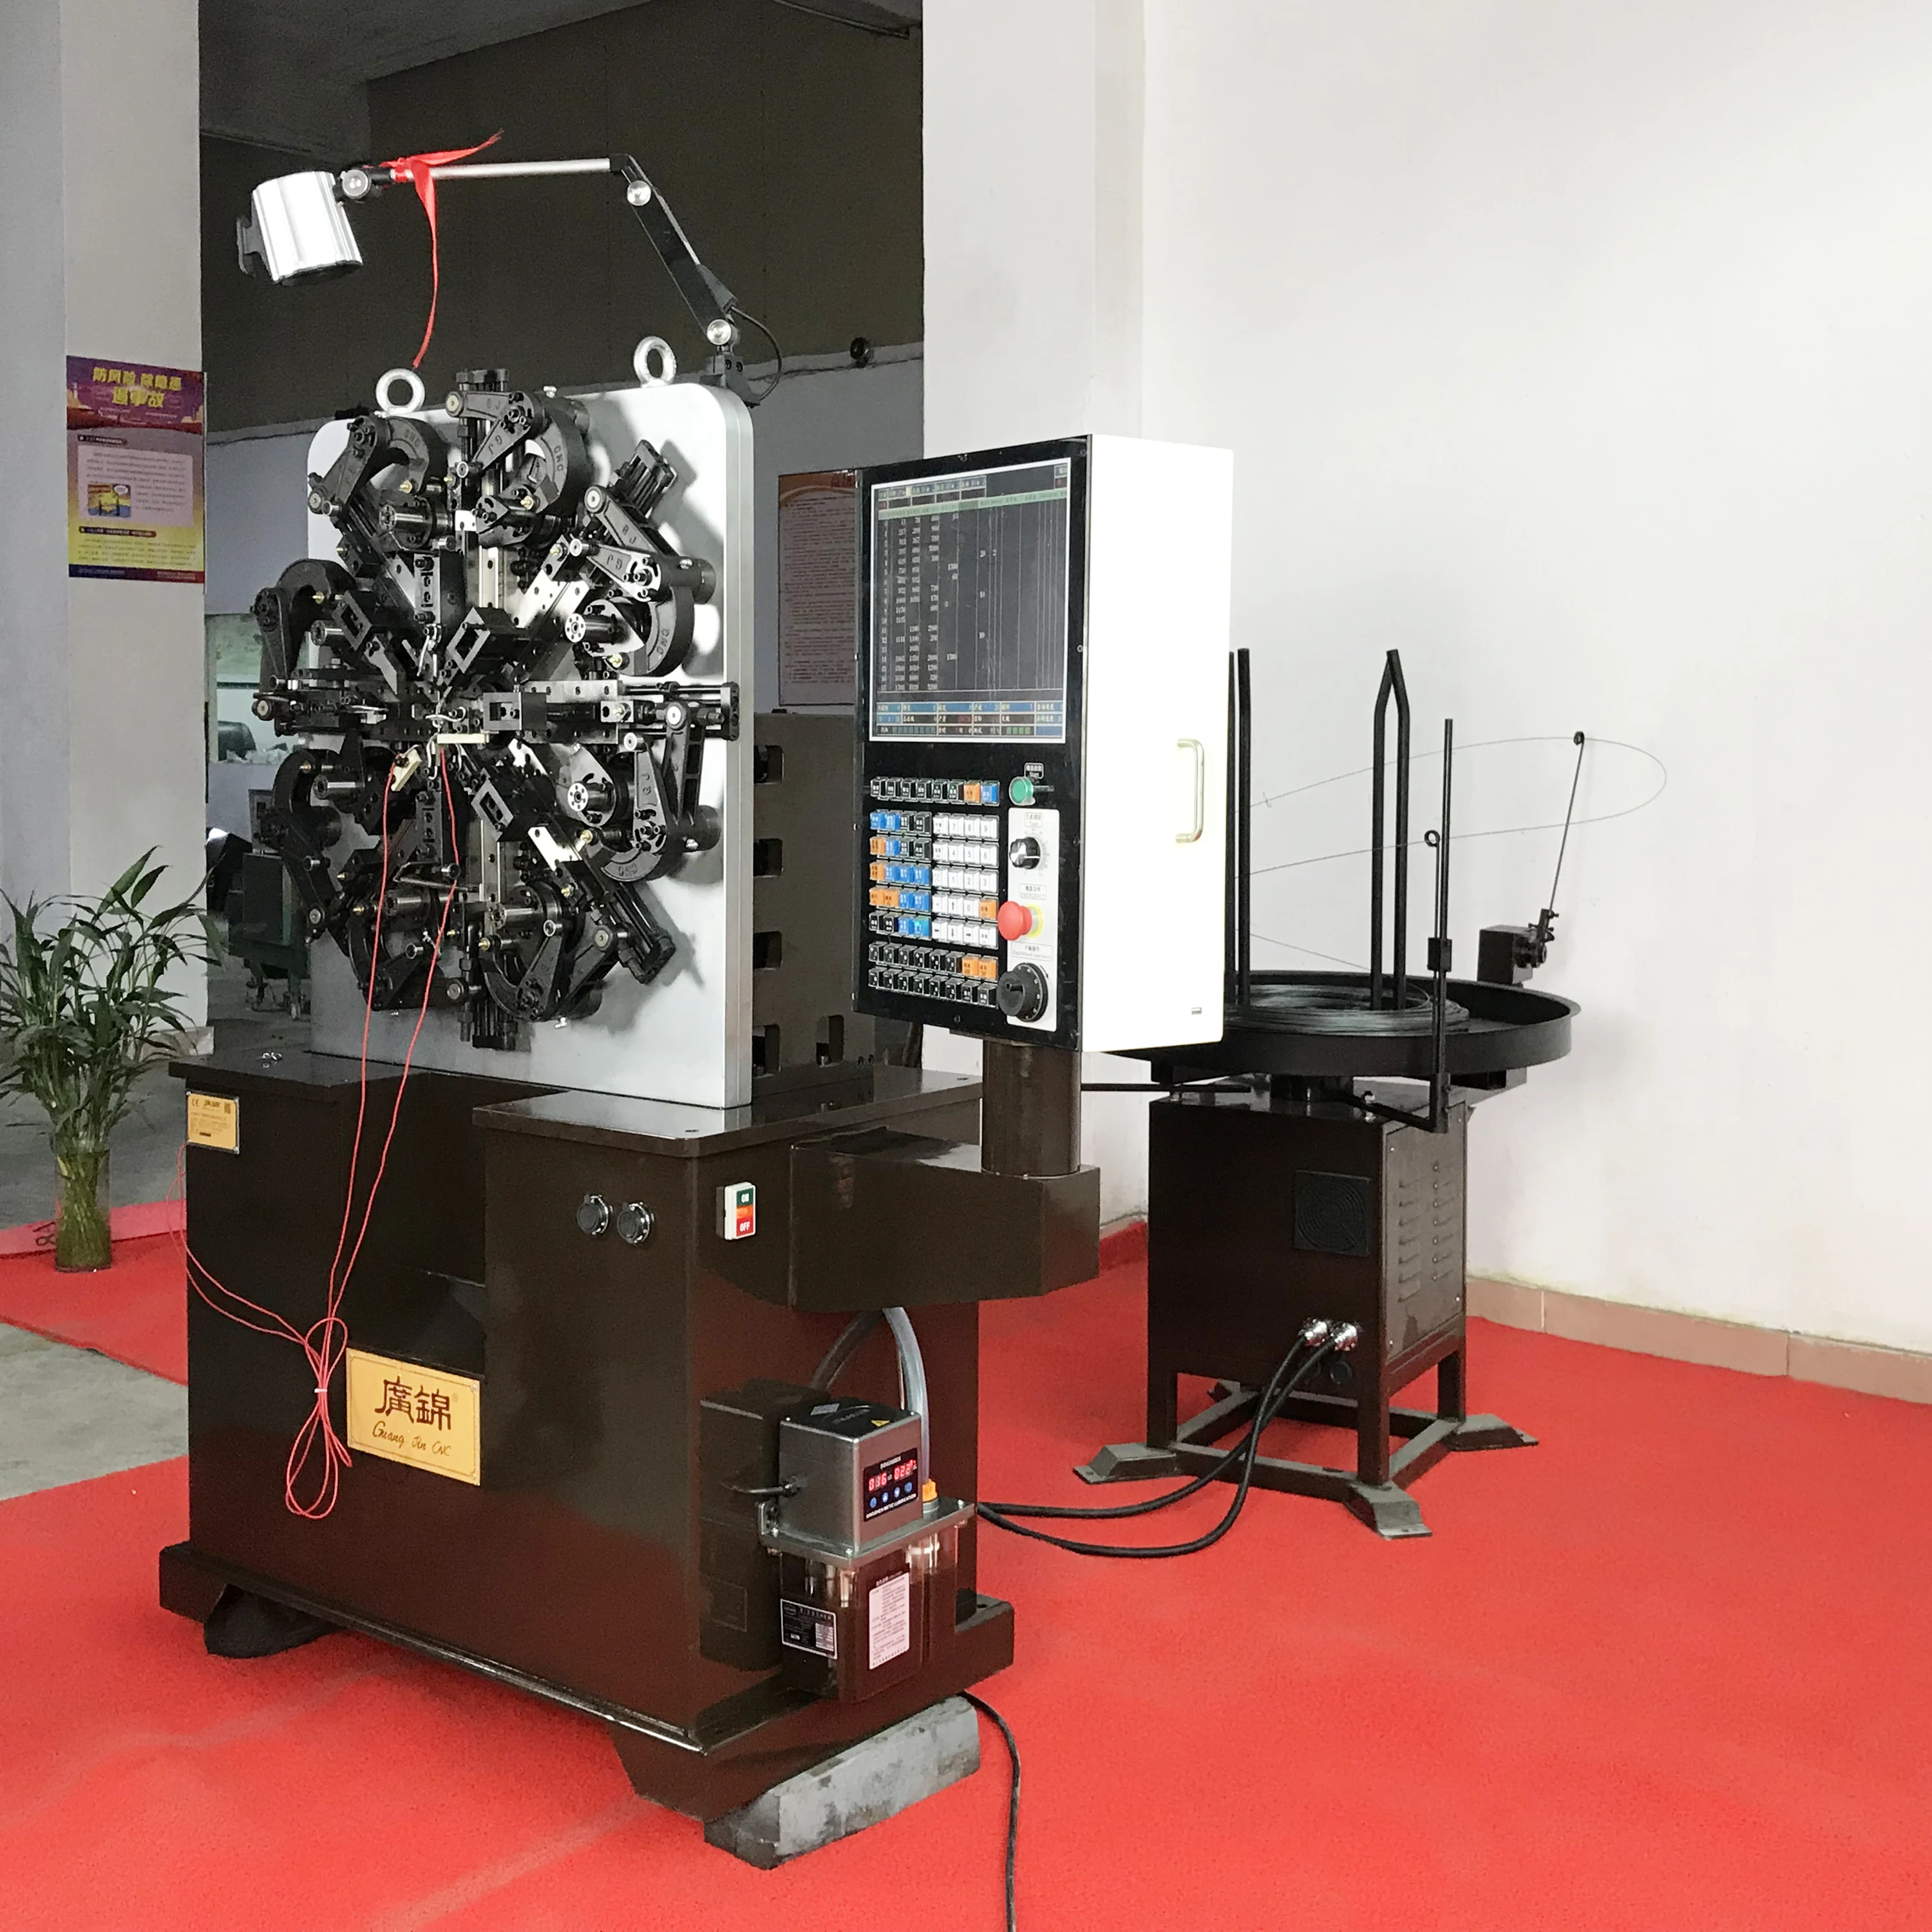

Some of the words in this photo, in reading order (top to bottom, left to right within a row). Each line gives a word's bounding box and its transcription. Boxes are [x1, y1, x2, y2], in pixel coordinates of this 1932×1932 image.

[741, 1193, 749, 1203] ON
[740, 1222, 750, 1231] OFF
[374, 1376, 451, 1431] 廣錦
[372, 1420, 404, 1448] Guang
[412, 1435, 426, 1450] Jin
[432, 1441, 451, 1456] CNC
